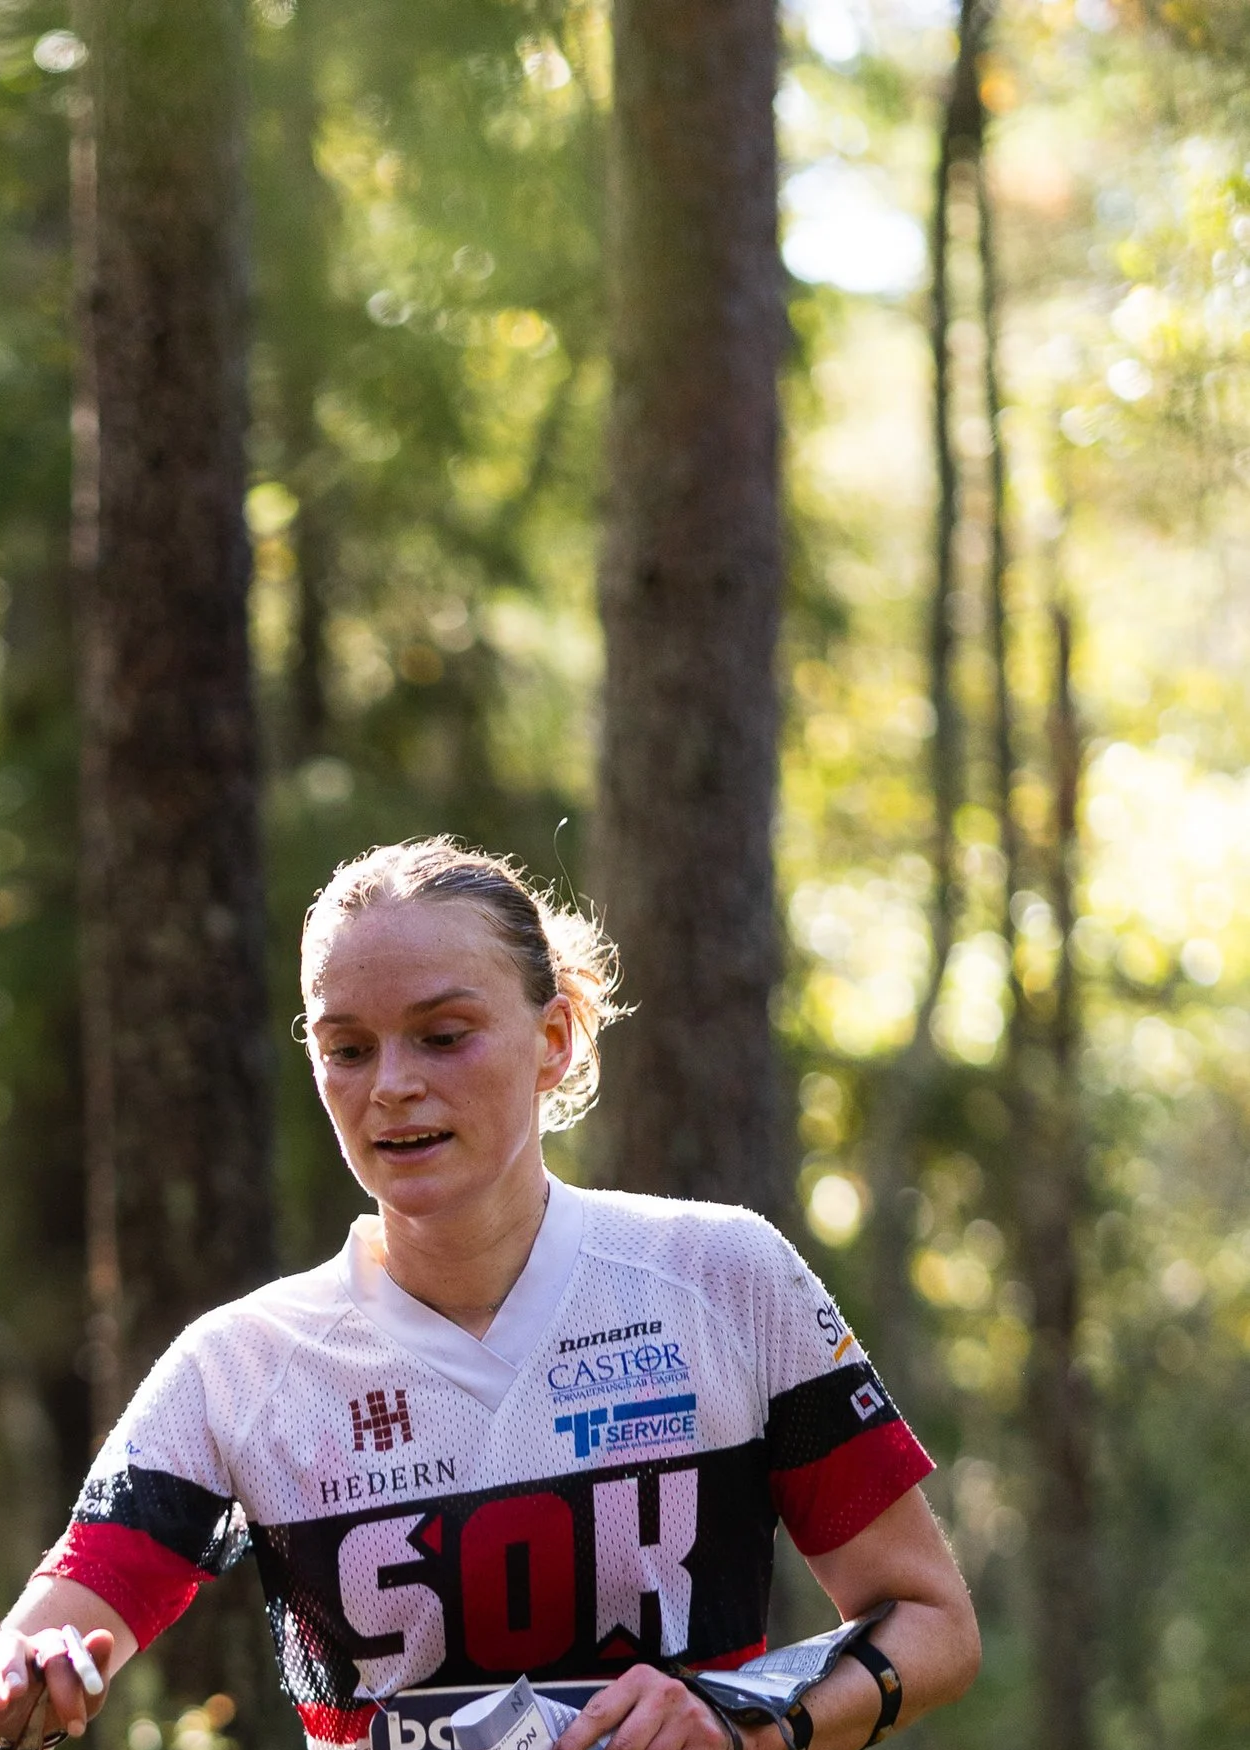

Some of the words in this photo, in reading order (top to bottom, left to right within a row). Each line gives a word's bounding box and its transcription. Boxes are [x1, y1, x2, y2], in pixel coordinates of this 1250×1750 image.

[559, 1320, 662, 1354] noname
[547, 1343, 687, 1391] CASTOR
[606, 1416, 695, 1444] SERVICE
[319, 1457, 456, 1505] HEDERN
[338, 1468, 699, 1697] SOK
